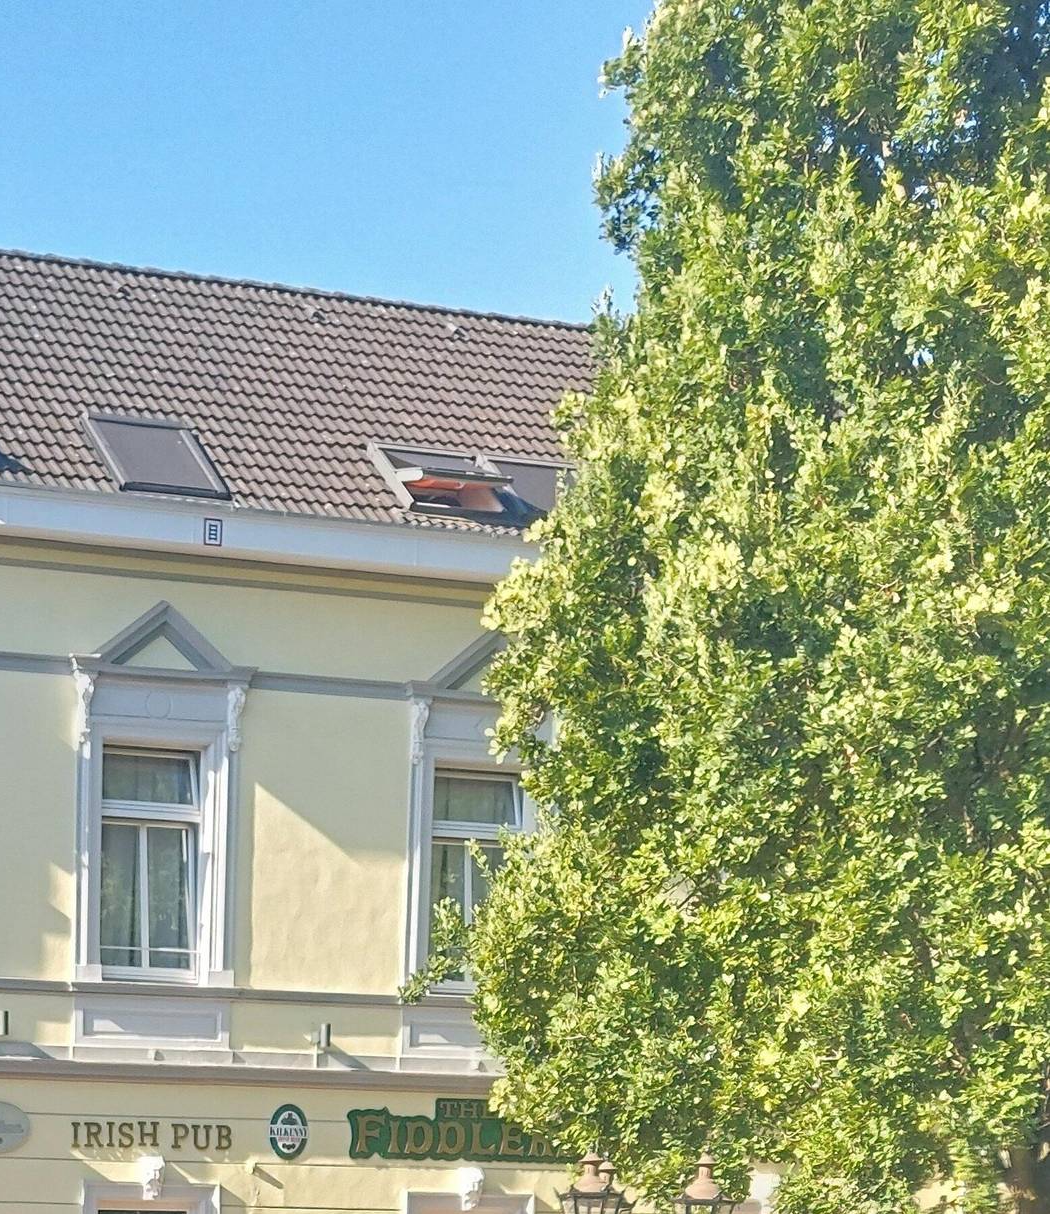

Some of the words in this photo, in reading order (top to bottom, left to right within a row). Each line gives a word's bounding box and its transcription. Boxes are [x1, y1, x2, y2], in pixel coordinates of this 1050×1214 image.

[70, 1121, 160, 1148] IRISH
[171, 1123, 233, 1151] PUB
[355, 1114, 572, 1158] FIDDLER
